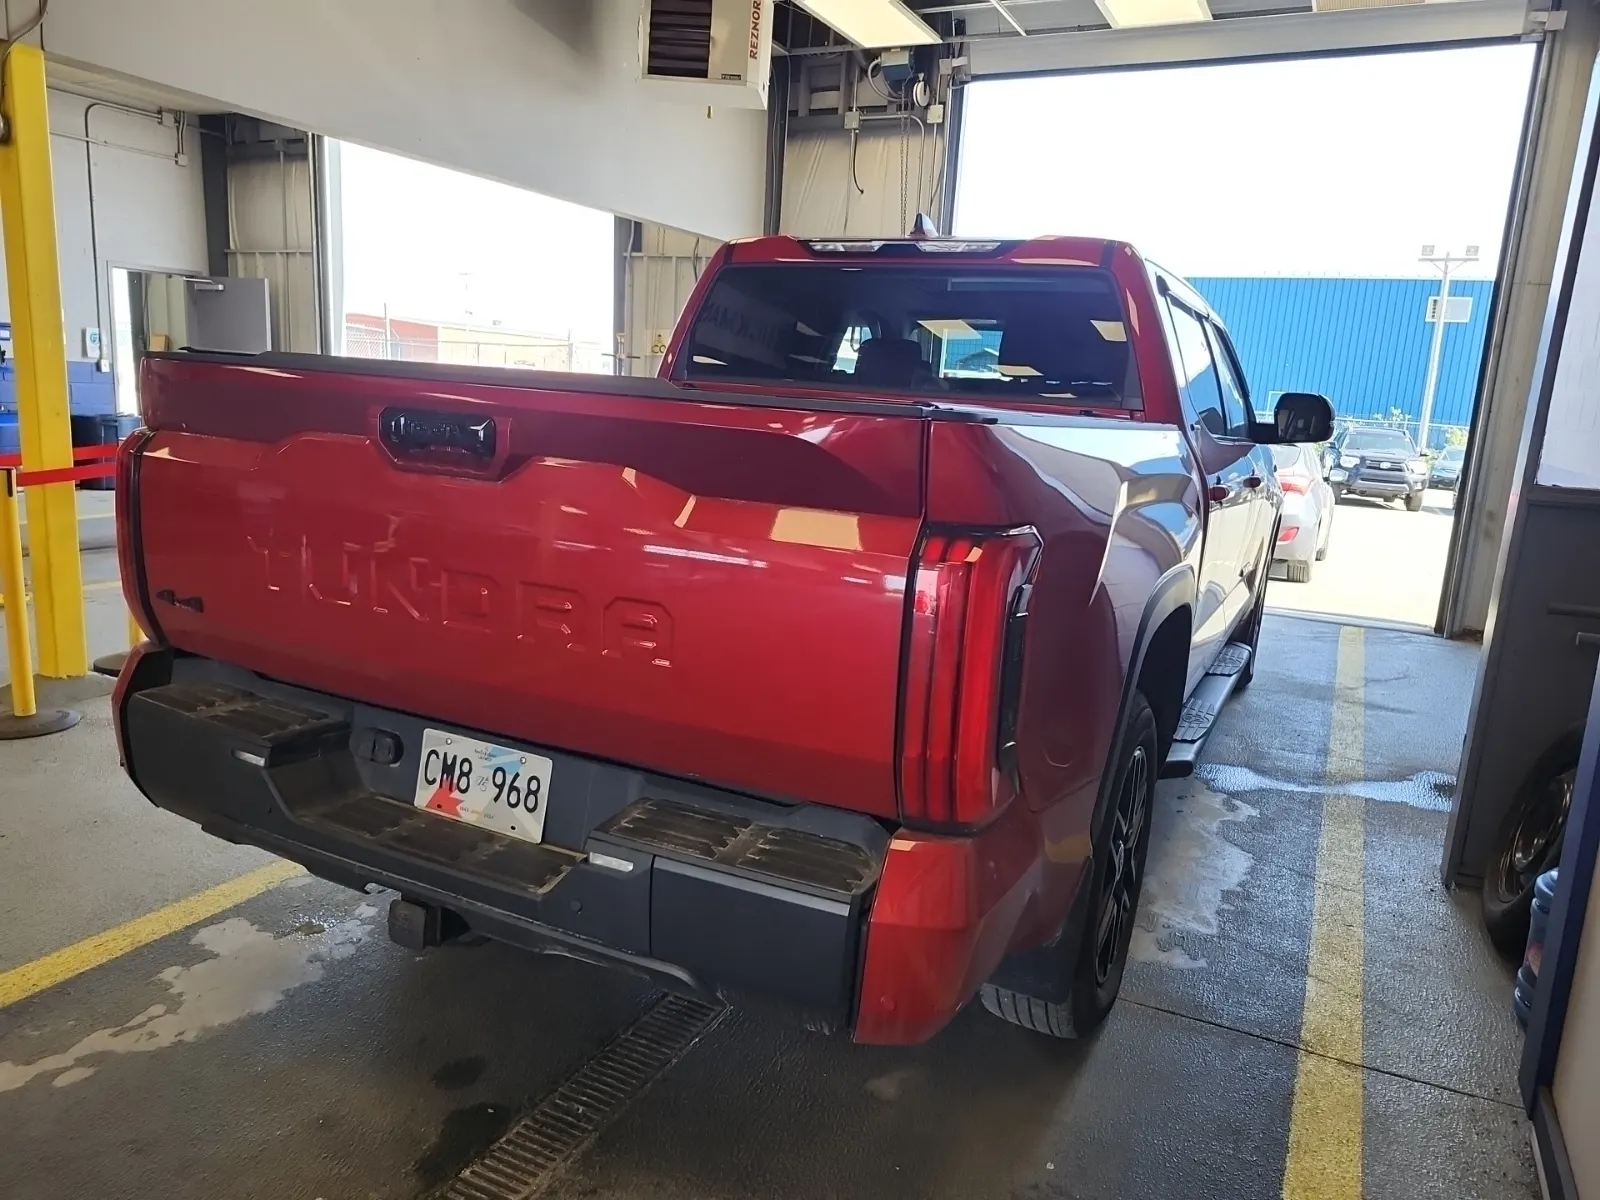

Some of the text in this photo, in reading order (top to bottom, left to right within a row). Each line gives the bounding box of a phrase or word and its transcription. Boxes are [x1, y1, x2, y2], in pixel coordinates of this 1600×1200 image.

[749, 0, 762, 60] REZNOR
[246, 528, 676, 669] TUNDRA
[424, 749, 541, 813] CM8 968
